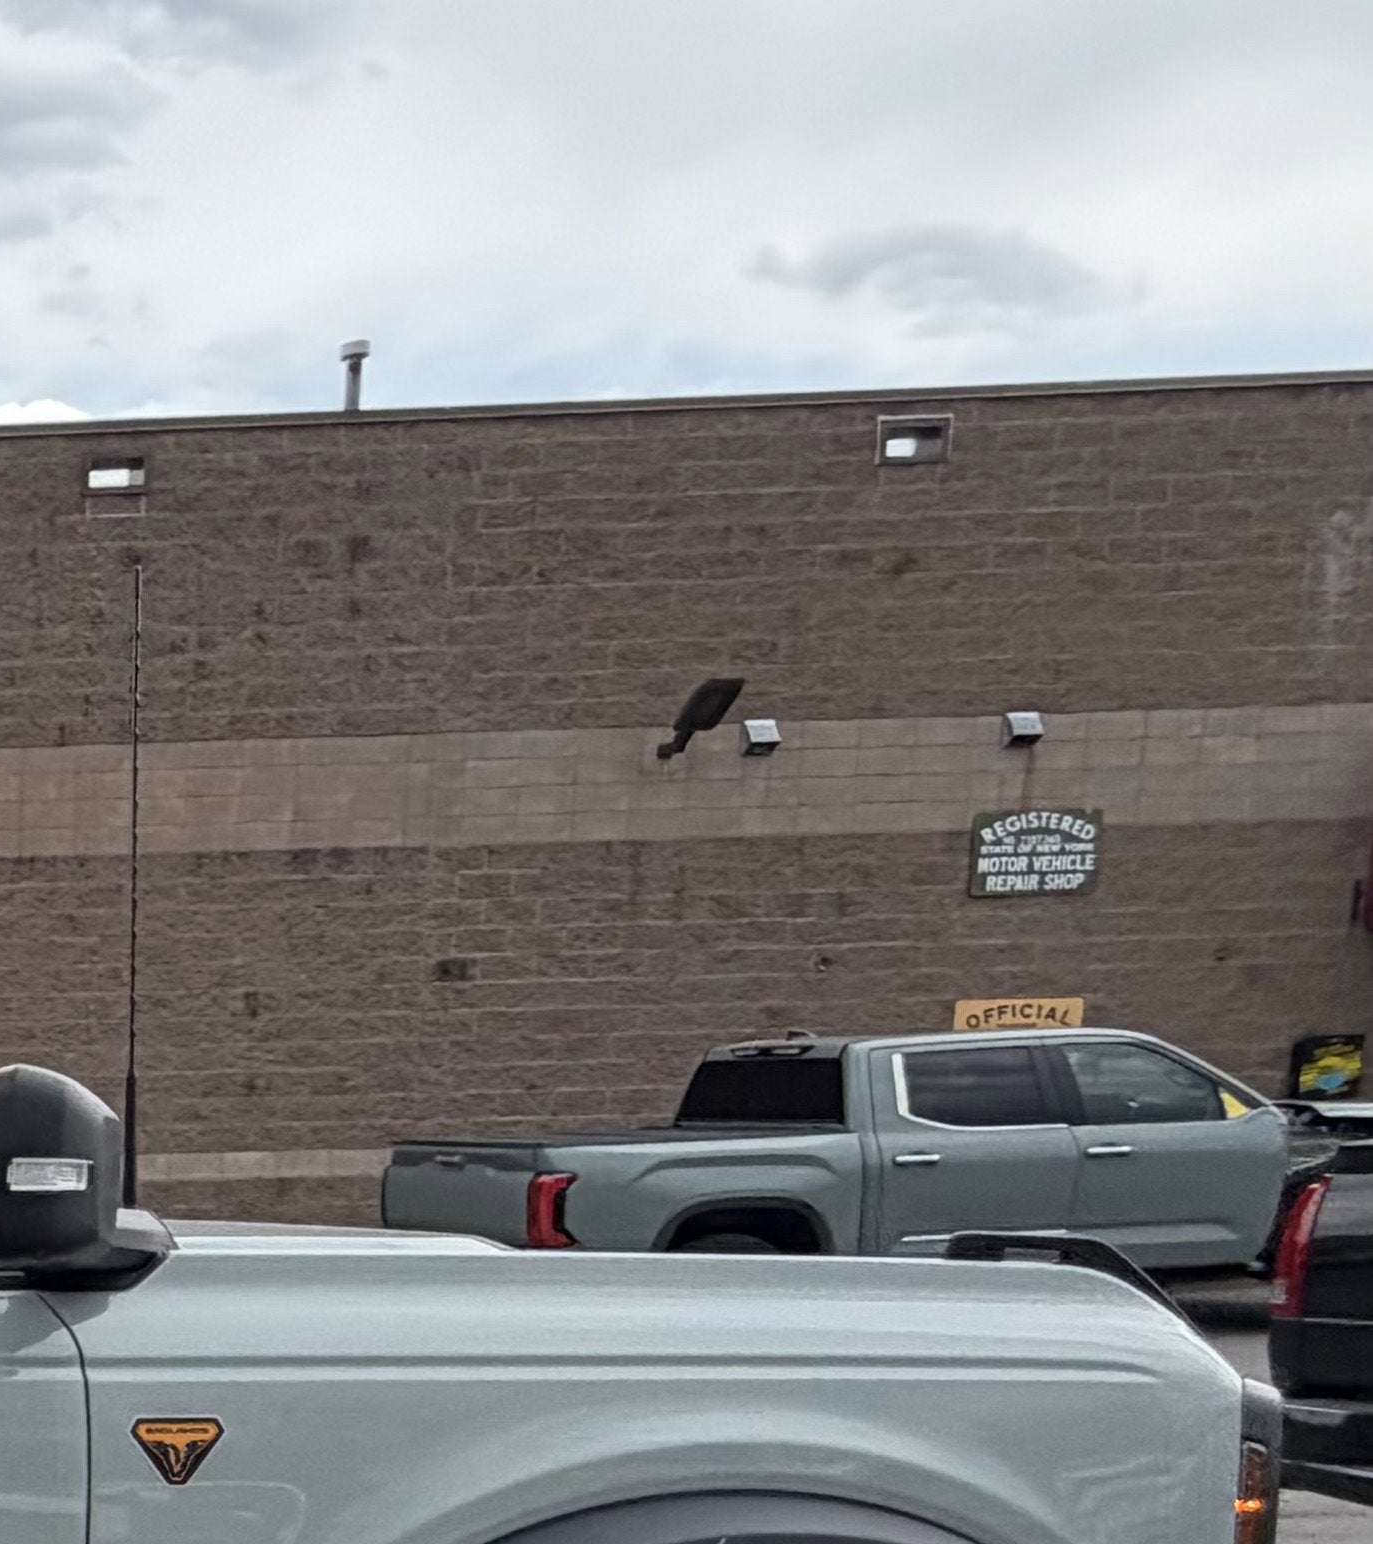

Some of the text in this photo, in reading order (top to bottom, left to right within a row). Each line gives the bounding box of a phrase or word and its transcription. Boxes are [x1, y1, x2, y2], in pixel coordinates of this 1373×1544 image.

[980, 811, 1096, 843] REGISTERED
[980, 842, 1095, 855] STATE OF NEW YORK
[977, 853, 1097, 874] MOTOR VEHICLE
[986, 873, 1086, 892] REPAIR SHOP
[966, 1003, 1072, 1029] OFFICIAL
